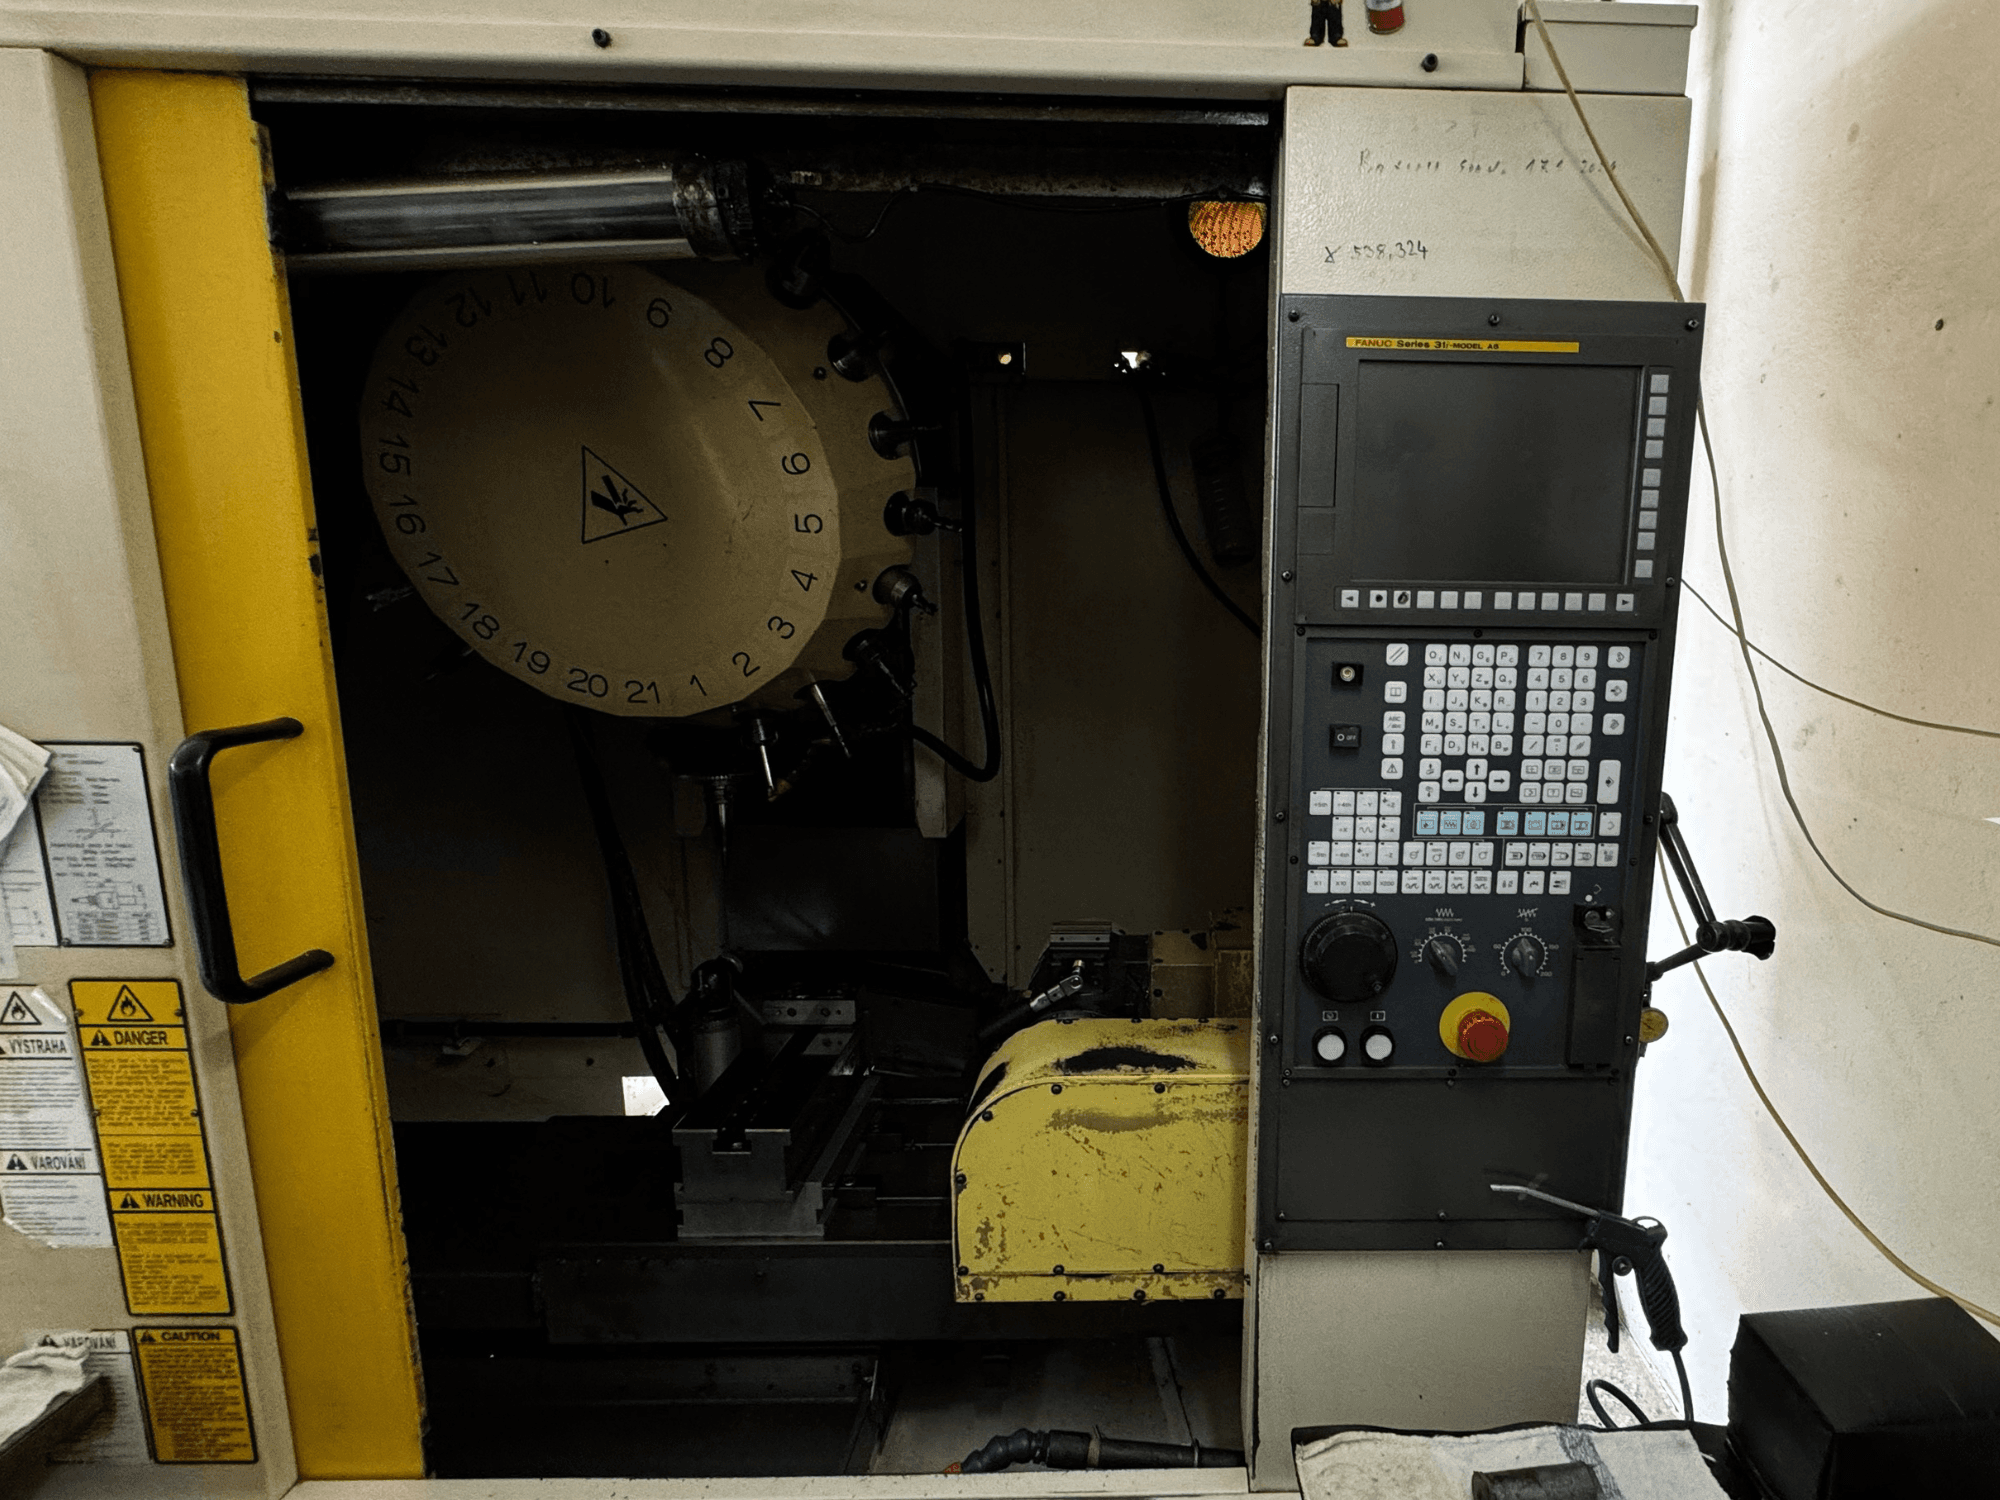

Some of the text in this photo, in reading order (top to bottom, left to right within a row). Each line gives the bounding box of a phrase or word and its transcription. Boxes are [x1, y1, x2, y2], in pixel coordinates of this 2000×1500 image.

[507, 271, 547, 305] 11
[571, 271, 615, 308] 10
[445, 288, 491, 327] 12
[647, 298, 672, 328] 9
[405, 325, 447, 366] 13
[1355, 339, 1392, 347] FANUC
[1397, 340, 1430, 348] Series
[704, 337, 733, 368] 8
[382, 377, 419, 418] 14
[748, 401, 781, 421] 7
[379, 434, 410, 475] 15
[782, 453, 810, 475] 6
[389, 495, 425, 534] 16
[795, 514, 823, 533] 5
[418, 552, 459, 585] 17
[791, 570, 817, 591] 4
[462, 603, 499, 639] 18
[768, 616, 795, 639] 3
[514, 642, 550, 674] 19
[1429, 651, 1437, 659] O
[1453, 651, 1460, 659] N
[1477, 651, 1484, 659] G
[1501, 652, 1508, 660] P
[1537, 652, 1543, 660] 7
[1584, 653, 1590, 661] 9
[732, 652, 760, 677] 2
[567, 668, 608, 697] 20
[1428, 673, 1435, 681] X
[1452, 674, 1459, 682] Y
[1476, 674, 1482, 682] Z
[1499, 674, 1506, 682] Q
[1559, 675, 1565, 683] 5
[1582, 675, 1588, 683] 6
[625, 681, 660, 703] 21
[690, 675, 707, 696] 1
[1557, 697, 1563, 705] 2
[1580, 698, 1587, 706] 3
[1450, 719, 1456, 727] S
[1473, 719, 1480, 727] T
[1497, 719, 1503, 727] L
[1448, 741, 1455, 749] D
[1472, 741, 1479, 749] H
[1495, 741, 1502, 749] B
[113, 1030, 169, 1045] DANGER
[142, 1193, 204, 1208] WARNING
[161, 1331, 220, 1341] CAUTION
